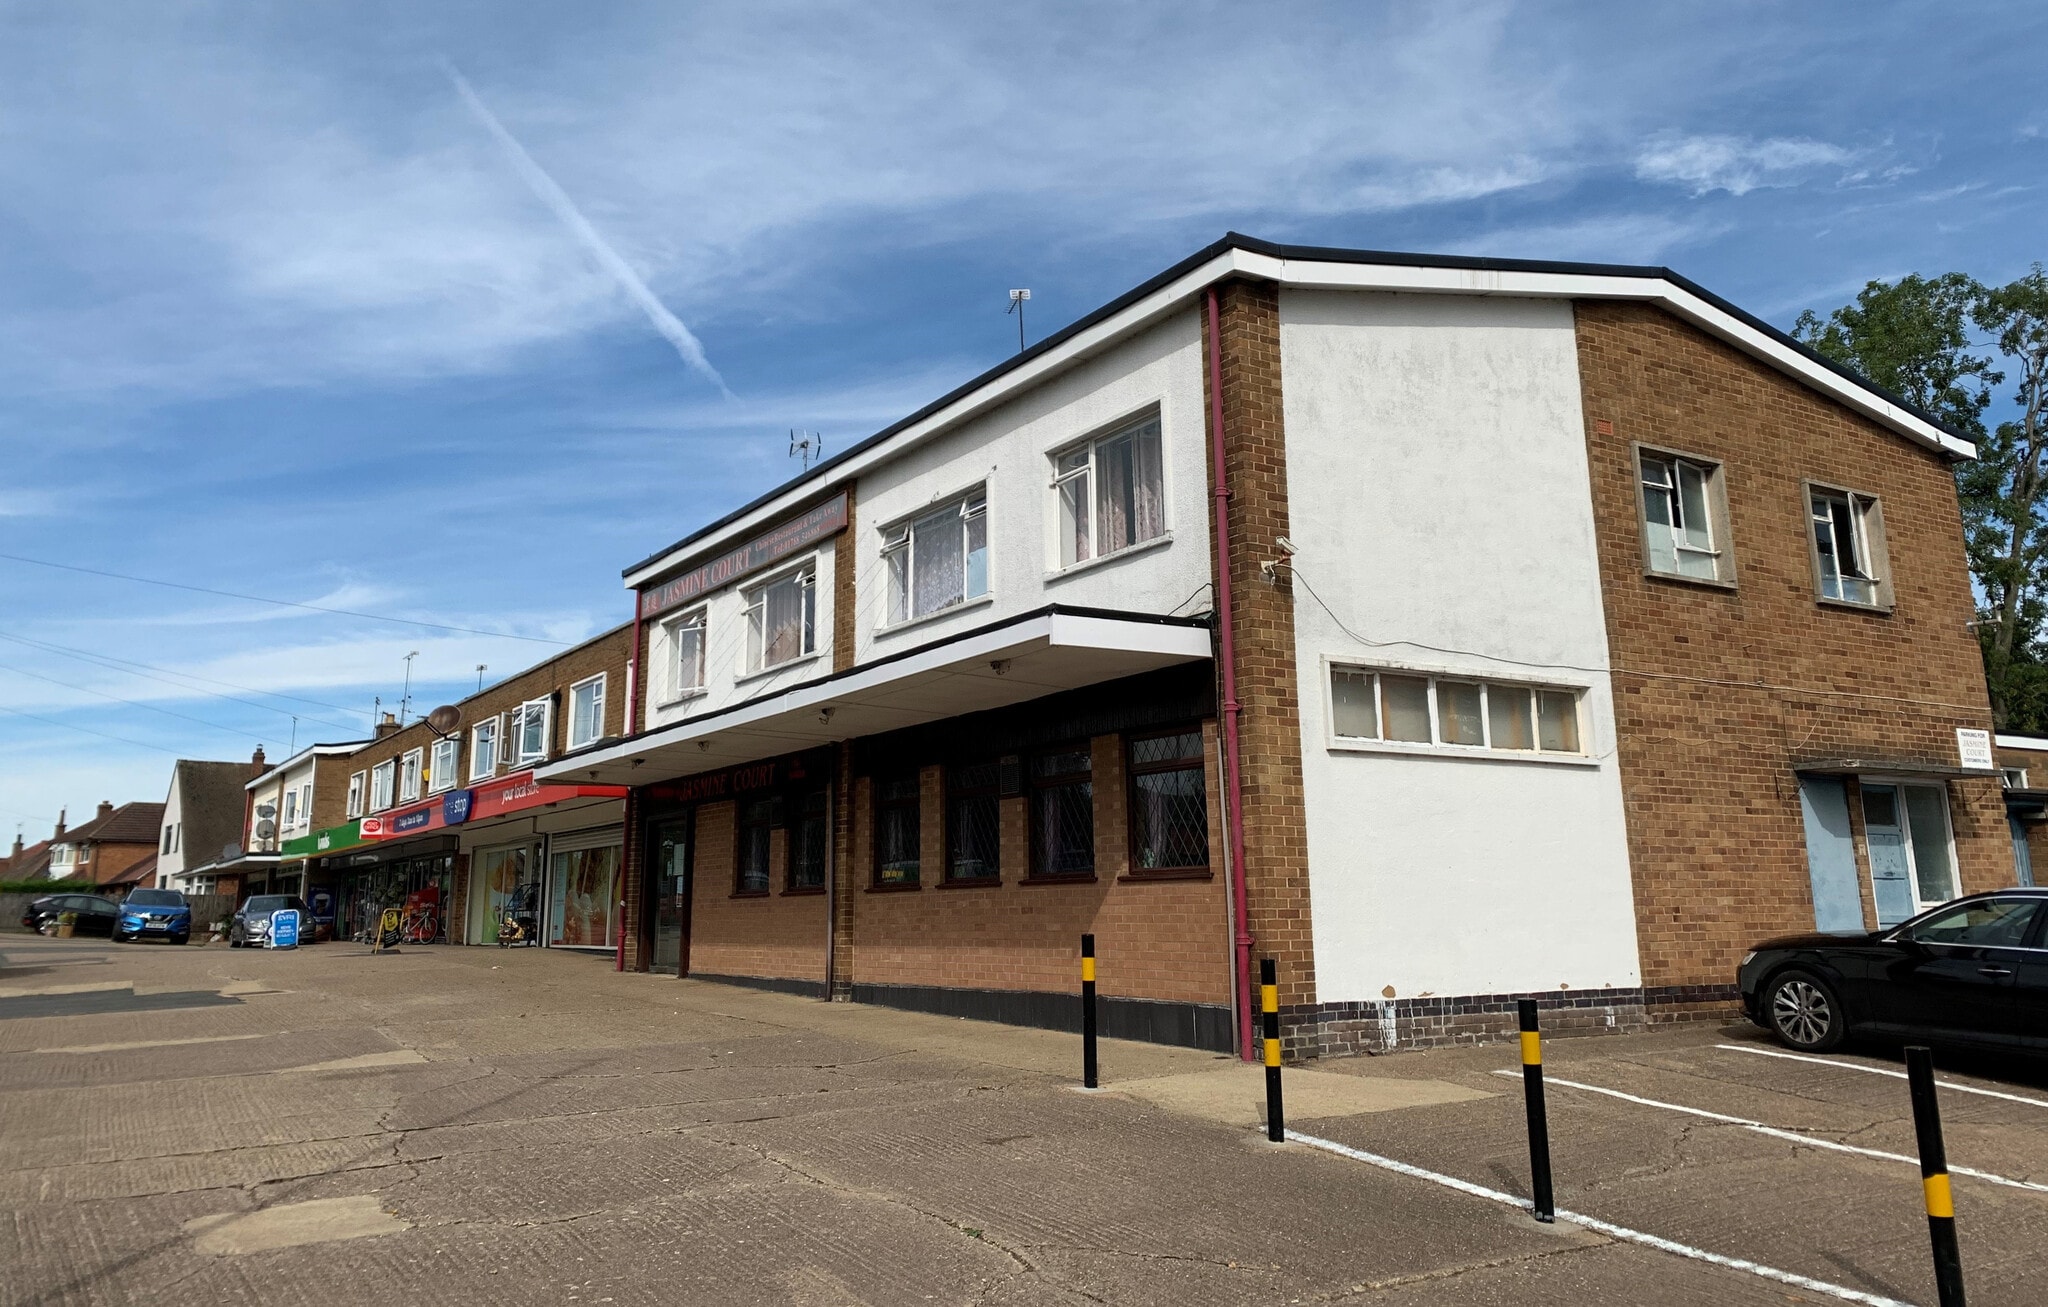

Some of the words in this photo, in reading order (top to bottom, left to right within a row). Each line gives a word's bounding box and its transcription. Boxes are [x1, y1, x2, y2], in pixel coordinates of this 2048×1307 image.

[662, 568, 709, 606] JASMINE
[711, 547, 752, 583] COURT
[1966, 748, 1985, 756] COURT
[680, 773, 729, 802] JASMINE
[732, 762, 776, 792] COURT
[501, 789, 514, 805] your
